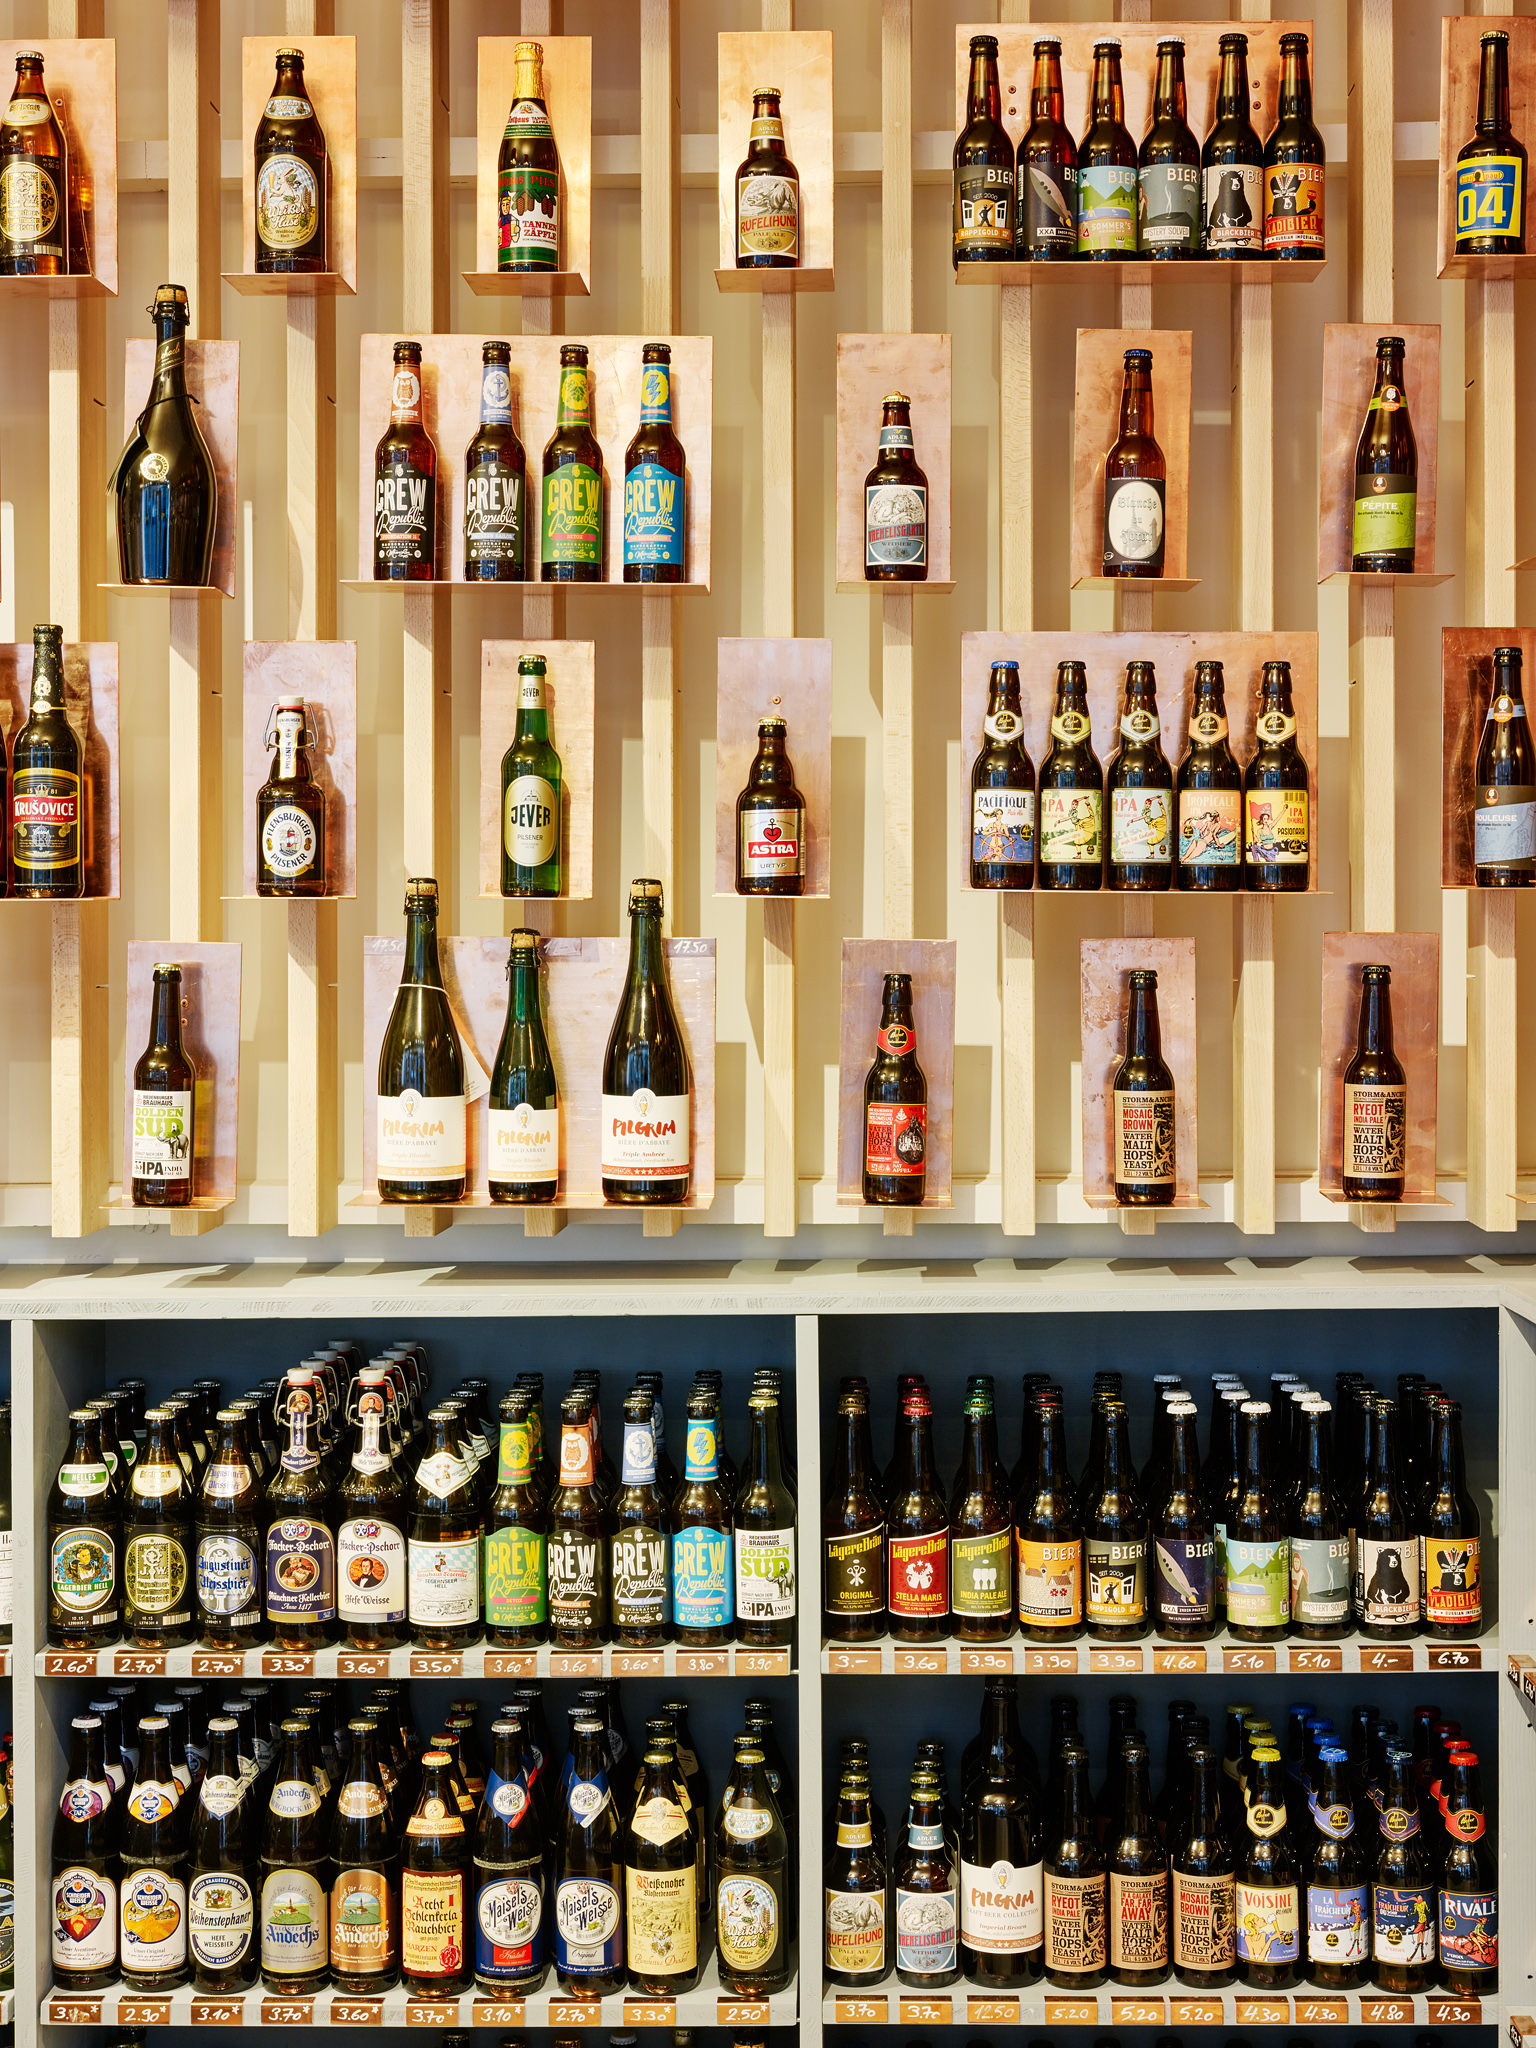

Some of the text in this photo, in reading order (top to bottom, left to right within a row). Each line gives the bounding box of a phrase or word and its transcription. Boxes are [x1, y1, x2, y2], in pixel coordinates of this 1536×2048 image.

[531, 175, 557, 188] PILS
[987, 168, 1013, 186] BIER
[1108, 170, 1136, 186] BIER
[1167, 168, 1197, 184] BIER
[1298, 167, 1325, 184] BIER
[1458, 186, 1506, 228] 04
[741, 214, 797, 234] RUFELIHUND
[376, 478, 427, 515] CREW
[468, 478, 519, 515] CREW
[549, 478, 599, 515] CREW
[625, 478, 675, 517] CREW
[376, 504, 427, 538] Republic
[467, 503, 519, 538] Republic
[549, 504, 600, 538] Republic
[625, 506, 675, 540] Republic
[15, 799, 75, 817] KRUŠOVICE
[1044, 798, 1064, 812] IPA
[1116, 798, 1138, 812] IPA
[511, 804, 551, 829] JEVER
[1289, 808, 1304, 820] IPA
[266, 812, 312, 837] FLENSBURGER
[751, 843, 796, 856] ASTRA
[267, 853, 308, 869] PILSENER
[673, 938, 708, 954] 17.50
[136, 1107, 184, 1118] DOLDEN
[1123, 1108, 1153, 1119] MOSAIC
[1353, 1103, 1384, 1116] RYEOT
[383, 1117, 445, 1138] PILGRIM
[613, 1117, 676, 1138] PILGRIM
[1123, 1119, 1153, 1130] BROWN
[1369, 1116, 1384, 1124] PALE
[136, 1118, 184, 1138] SUD
[1353, 1126, 1384, 1135] WATER
[498, 1130, 551, 1147] PILGRIM
[1123, 1132, 1153, 1140] WATER
[1353, 1135, 1384, 1145] MALT
[1123, 1140, 1153, 1150] MALT
[1353, 1145, 1384, 1155] HOPS
[1124, 1150, 1154, 1161] HOPS
[1354, 1154, 1384, 1164] YEAST
[142, 1162, 164, 1176] IPA
[1124, 1160, 1153, 1169] YEAST
[740, 1546, 790, 1558] DOLDEN
[828, 1534, 883, 1560] LägereBräu
[892, 1538, 947, 1562] LägereBräu
[956, 1536, 1009, 1561] LägereBräu
[1042, 1546, 1075, 1561] BIER
[1111, 1545, 1144, 1560] BIER
[1185, 1544, 1214, 1558] BIER
[1239, 1546, 1274, 1562] BIER
[488, 1539, 541, 1578] CREW
[548, 1543, 596, 1581] CREW
[613, 1539, 665, 1577] CREW
[674, 1540, 726, 1577] CREW
[740, 1557, 790, 1578] SUD
[489, 1569, 542, 1600] Republic
[548, 1573, 598, 1603] Republic
[614, 1569, 667, 1600] Republic
[675, 1569, 727, 1599] Republic
[840, 1590, 874, 1599] ORIGINAL
[896, 1591, 944, 1602] STELLA MARIS
[960, 1590, 997, 1599] INDIA PALE
[752, 1602, 775, 1617] IPA
[1375, 1603, 1413, 1614] BLACKBIER
[903, 1655, 938, 1670] 3.60
[967, 1655, 1007, 1668] 3.90
[1032, 1655, 1072, 1668] 3.90
[1097, 1655, 1137, 1668] 3.90
[1162, 1655, 1197, 1669] 4.60
[1229, 1653, 1264, 1668] 5.10
[1297, 1652, 1331, 1668] 5.10
[1437, 1652, 1470, 1664] 6.70
[275, 1787, 312, 1801] Andechs
[343, 1787, 379, 1803] Andechs
[412, 1895, 445, 1910] Aecht
[971, 1887, 1034, 1912] PILGRIM
[1051, 1893, 1080, 1910] RYEOT
[1180, 1891, 1209, 1905] MOSAIC
[487, 1886, 527, 1927] Maisel's
[505, 1894, 538, 1930] Weisse
[562, 1887, 600, 1927] Maisel's
[575, 1896, 614, 1931] Weisse
[1121, 1907, 1151, 1921] AWAY
[1180, 1901, 1209, 1916] BROWN
[404, 1906, 458, 1923] Schlenkerla
[1181, 1916, 1209, 1926] WATER
[405, 1919, 456, 1936] Rauchbier
[1052, 1918, 1080, 1928] WATER
[1122, 1921, 1151, 1930] WATER
[1180, 1923, 1209, 1935] MALT
[265, 1924, 320, 1949] Andechs
[334, 1924, 390, 1949] Andechs
[827, 1927, 883, 1947] RUFELIHUND
[1052, 1926, 1081, 1938] MALT
[1122, 1928, 1151, 1938] MALT
[1052, 1936, 1082, 1949] HOPS
[1122, 1937, 1152, 1948] HOPS
[1180, 1933, 1210, 1947] HOPS
[1052, 1947, 1081, 1958] YEAST
[1122, 1946, 1151, 1956] YEAST
[1181, 1944, 1209, 1955] YEAST
[845, 2003, 876, 2017] 3.70
[974, 2004, 1014, 2020] 12.50
[1051, 2008, 1089, 2020] 5.20
[1120, 2006, 1158, 2021] 5.20
[1179, 2007, 1214, 2021] 5.20
[1243, 2004, 1281, 2021] 4.30
[1304, 2004, 1338, 2021] 4.30
[1370, 2004, 1404, 2021] 4.80
[1436, 2005, 1471, 2021] 4.30
